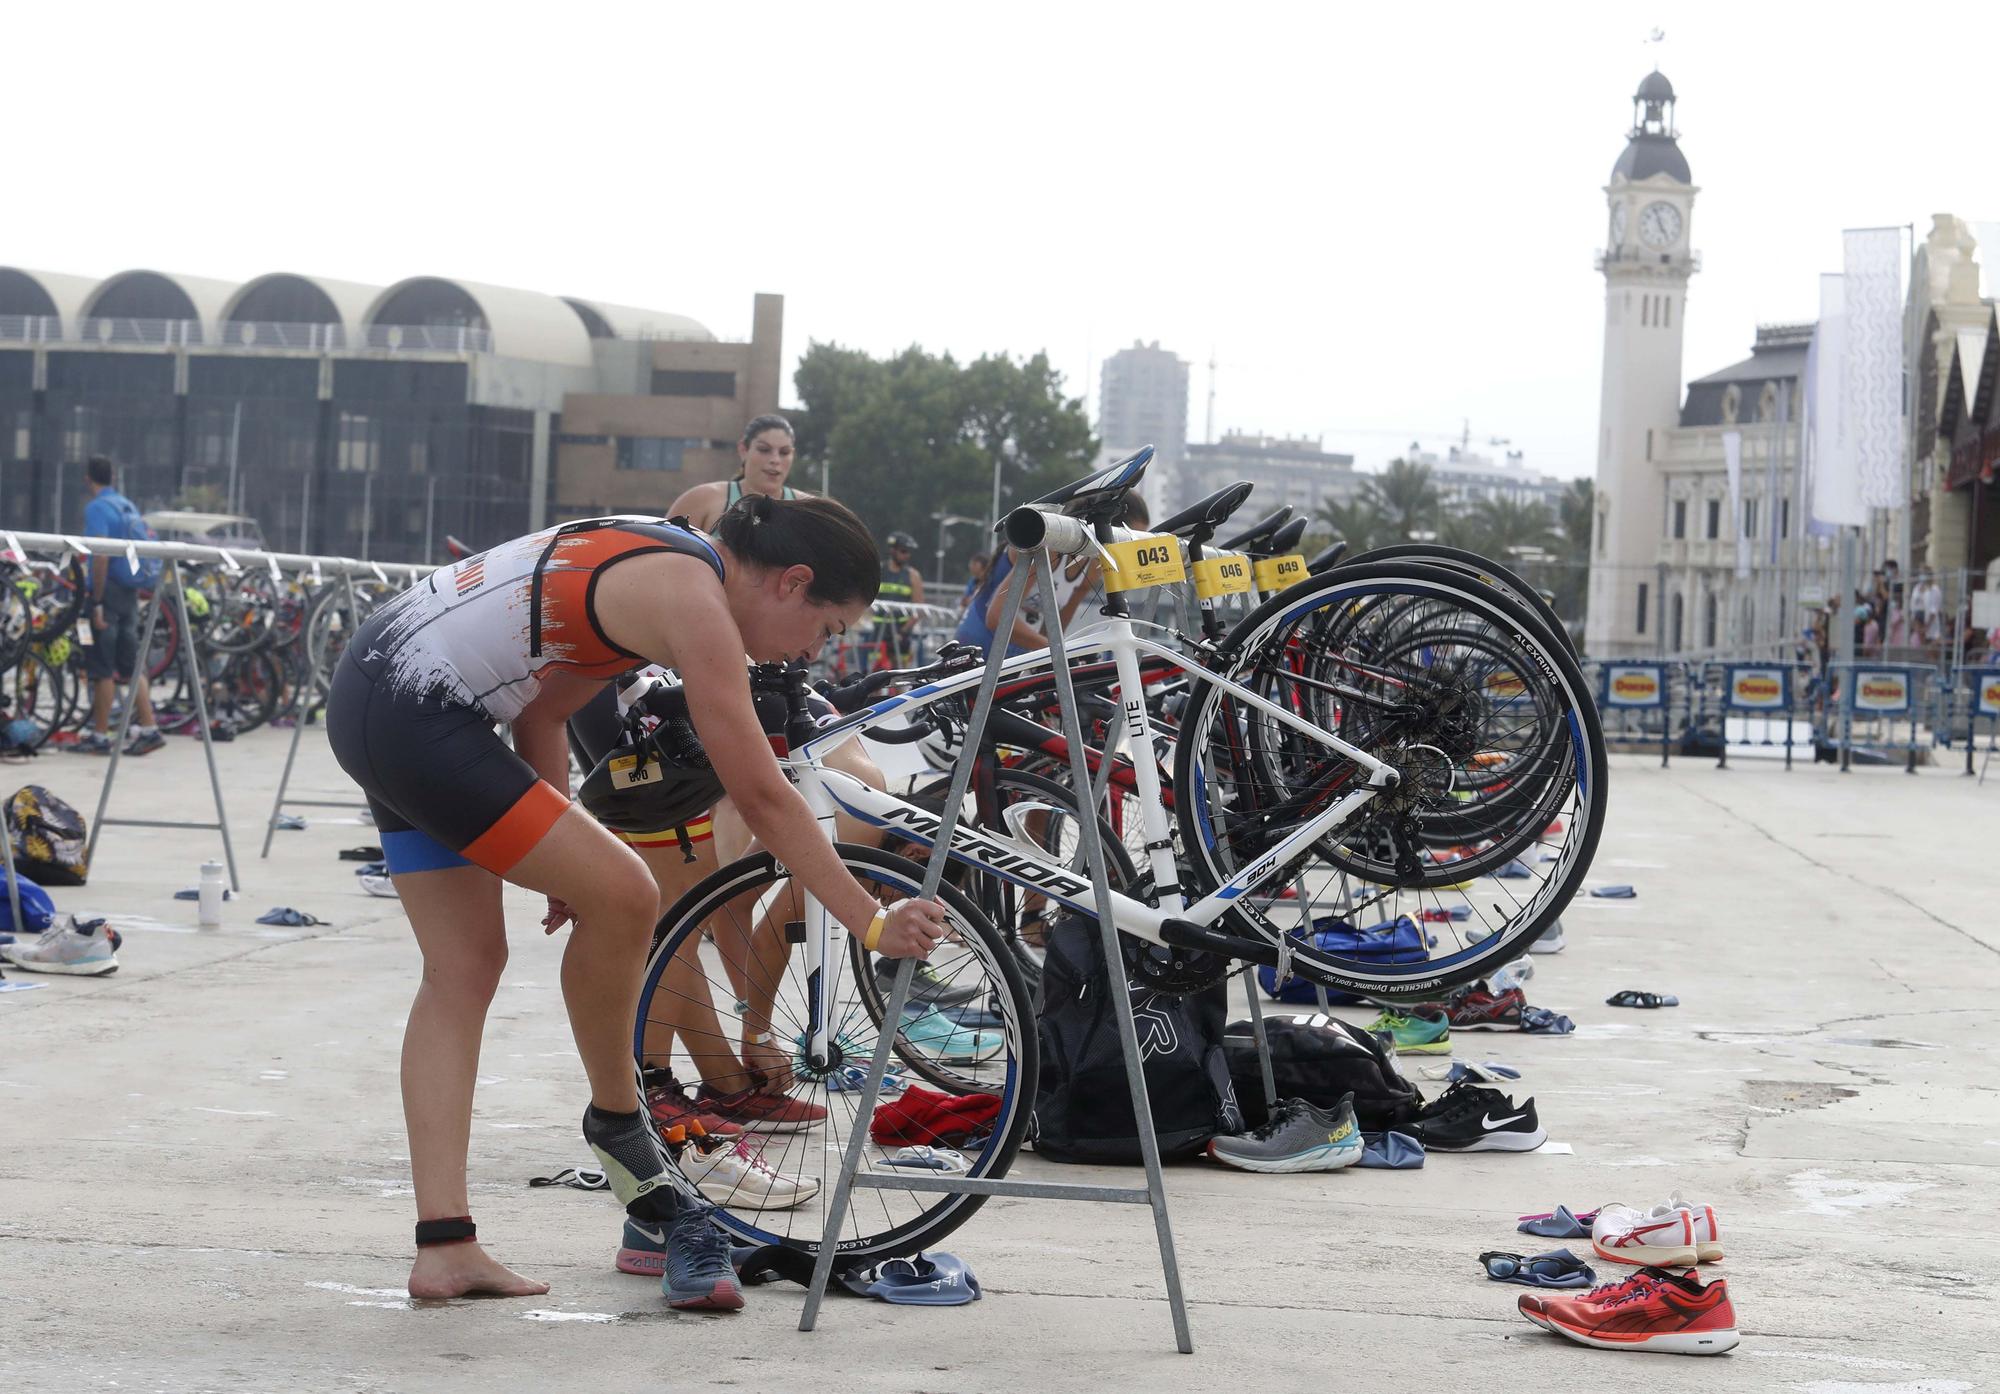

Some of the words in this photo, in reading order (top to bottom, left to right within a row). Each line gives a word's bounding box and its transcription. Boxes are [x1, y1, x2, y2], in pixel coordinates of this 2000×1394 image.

[1137, 546, 1170, 567] 043
[1220, 563, 1243, 579] 046
[1277, 561, 1299, 575] 049
[457, 581, 485, 598] ESPORT
[1513, 633, 1560, 687] ALEXRIMS
[1125, 700, 1144, 738] LITE
[881, 807, 1091, 898] MERIDA
[1246, 855, 1277, 886] 904
[1335, 977, 1353, 987] sport
[1352, 981, 1388, 993] Dynamic
[1389, 980, 1433, 993] MICHELIN
